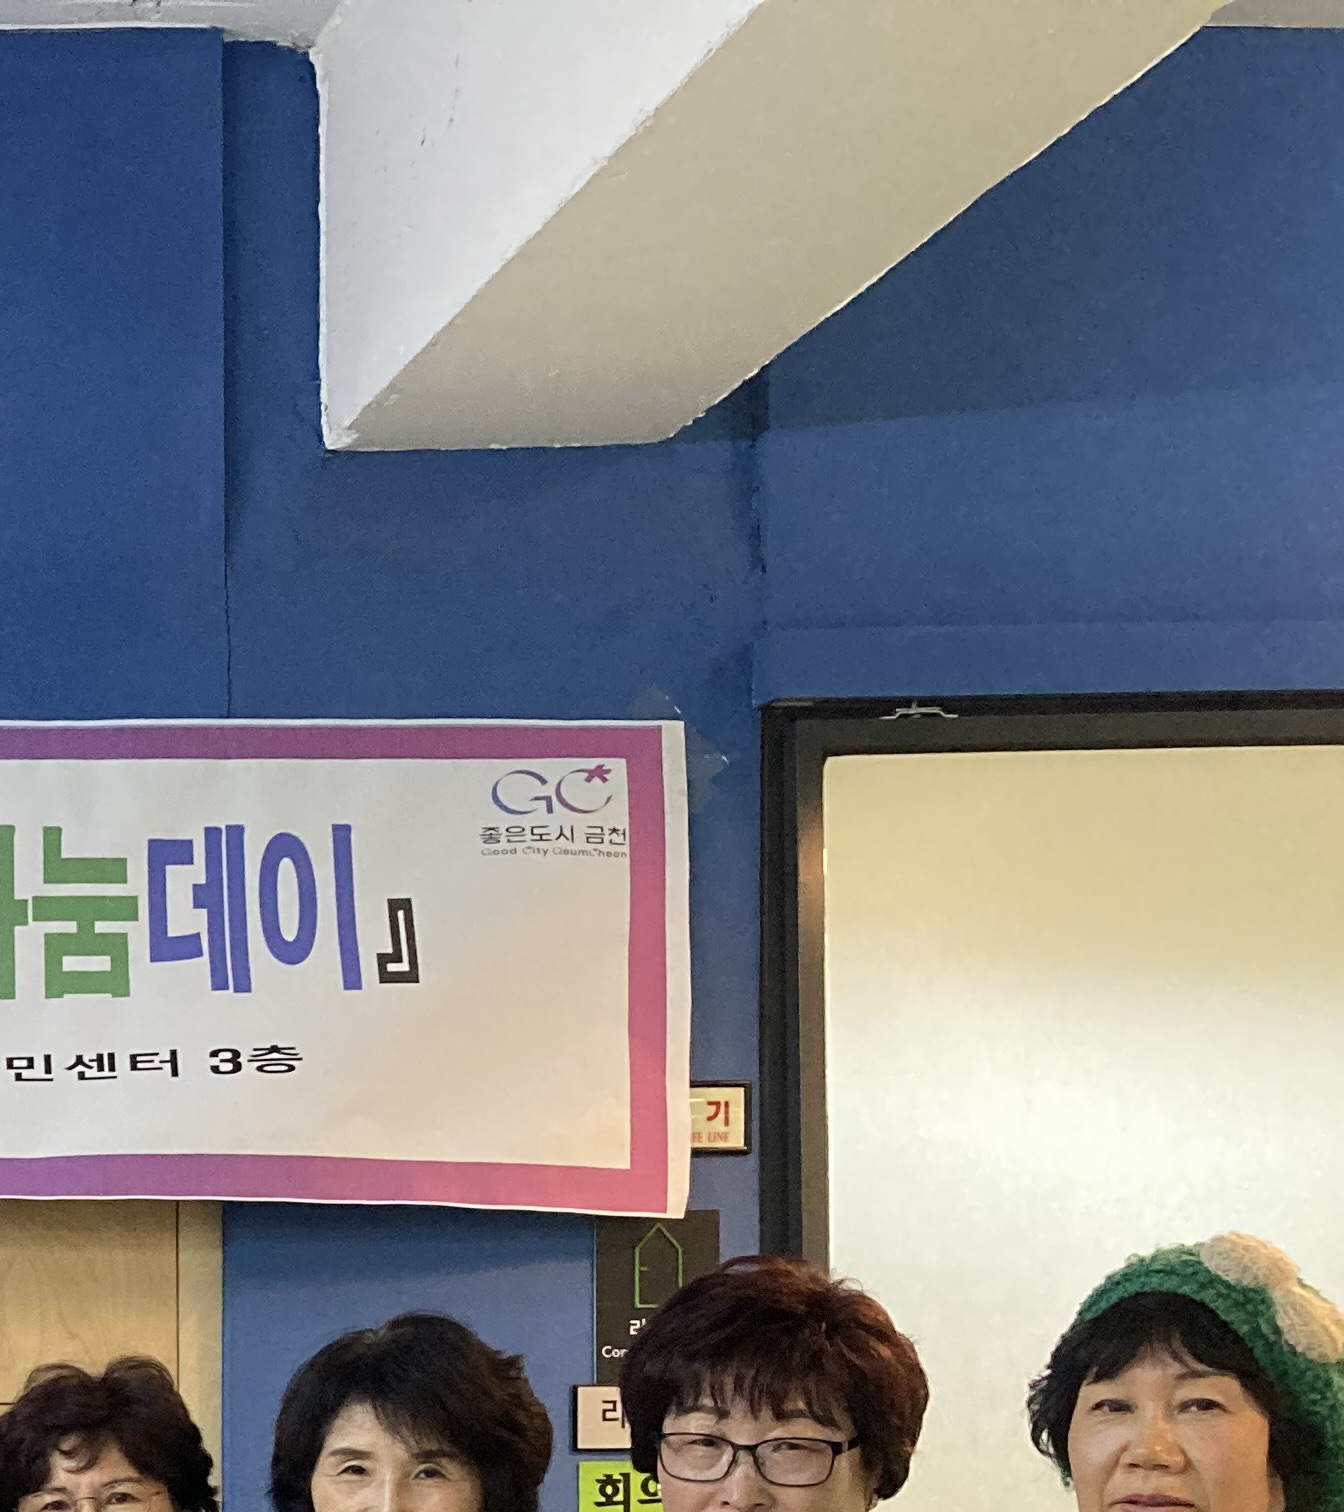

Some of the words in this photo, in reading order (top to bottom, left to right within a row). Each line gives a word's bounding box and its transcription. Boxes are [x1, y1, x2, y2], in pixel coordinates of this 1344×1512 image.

[479, 825, 575, 845] 좋은도시
[584, 825, 627, 846] 금천
[480, 846, 517, 857] Good
[208, 1044, 303, 1078] 3층
